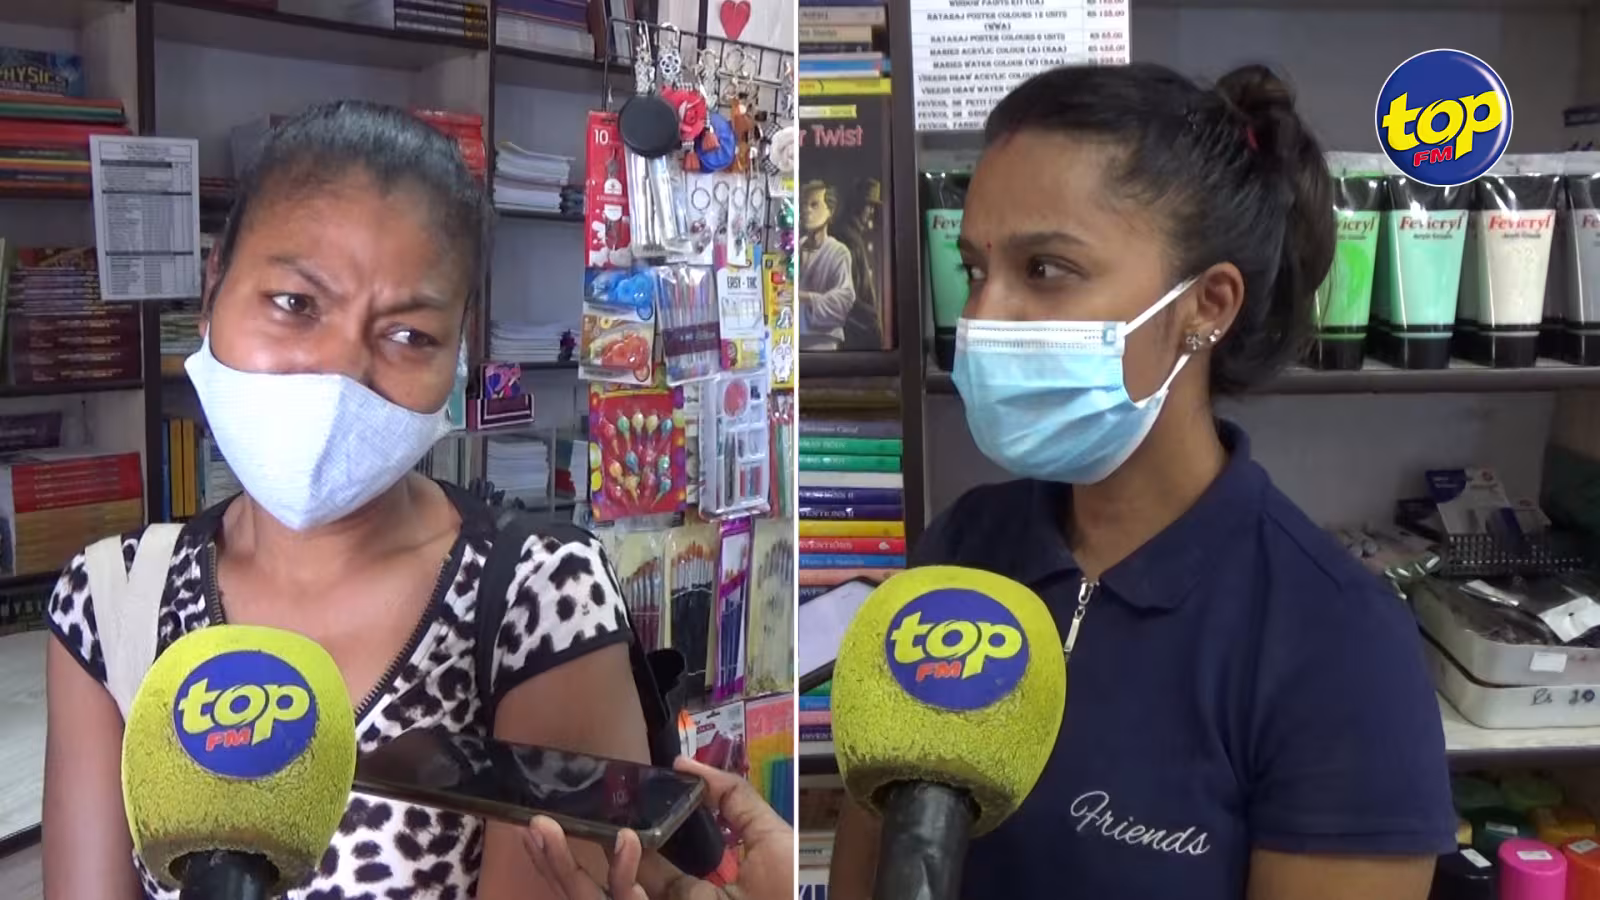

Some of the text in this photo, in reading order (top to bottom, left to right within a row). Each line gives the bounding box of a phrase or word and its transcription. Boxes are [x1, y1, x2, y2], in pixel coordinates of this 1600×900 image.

[594, 129, 609, 145] 10
[811, 124, 863, 147] Twist
[1399, 213, 1463, 233] Fevicryl
[1488, 213, 1552, 233] Fevicryl
[891, 611, 1022, 679] top
[915, 661, 963, 682] FM
[178, 678, 310, 746] top
[206, 728, 251, 751] FM
[1070, 790, 1211, 855] Friends
